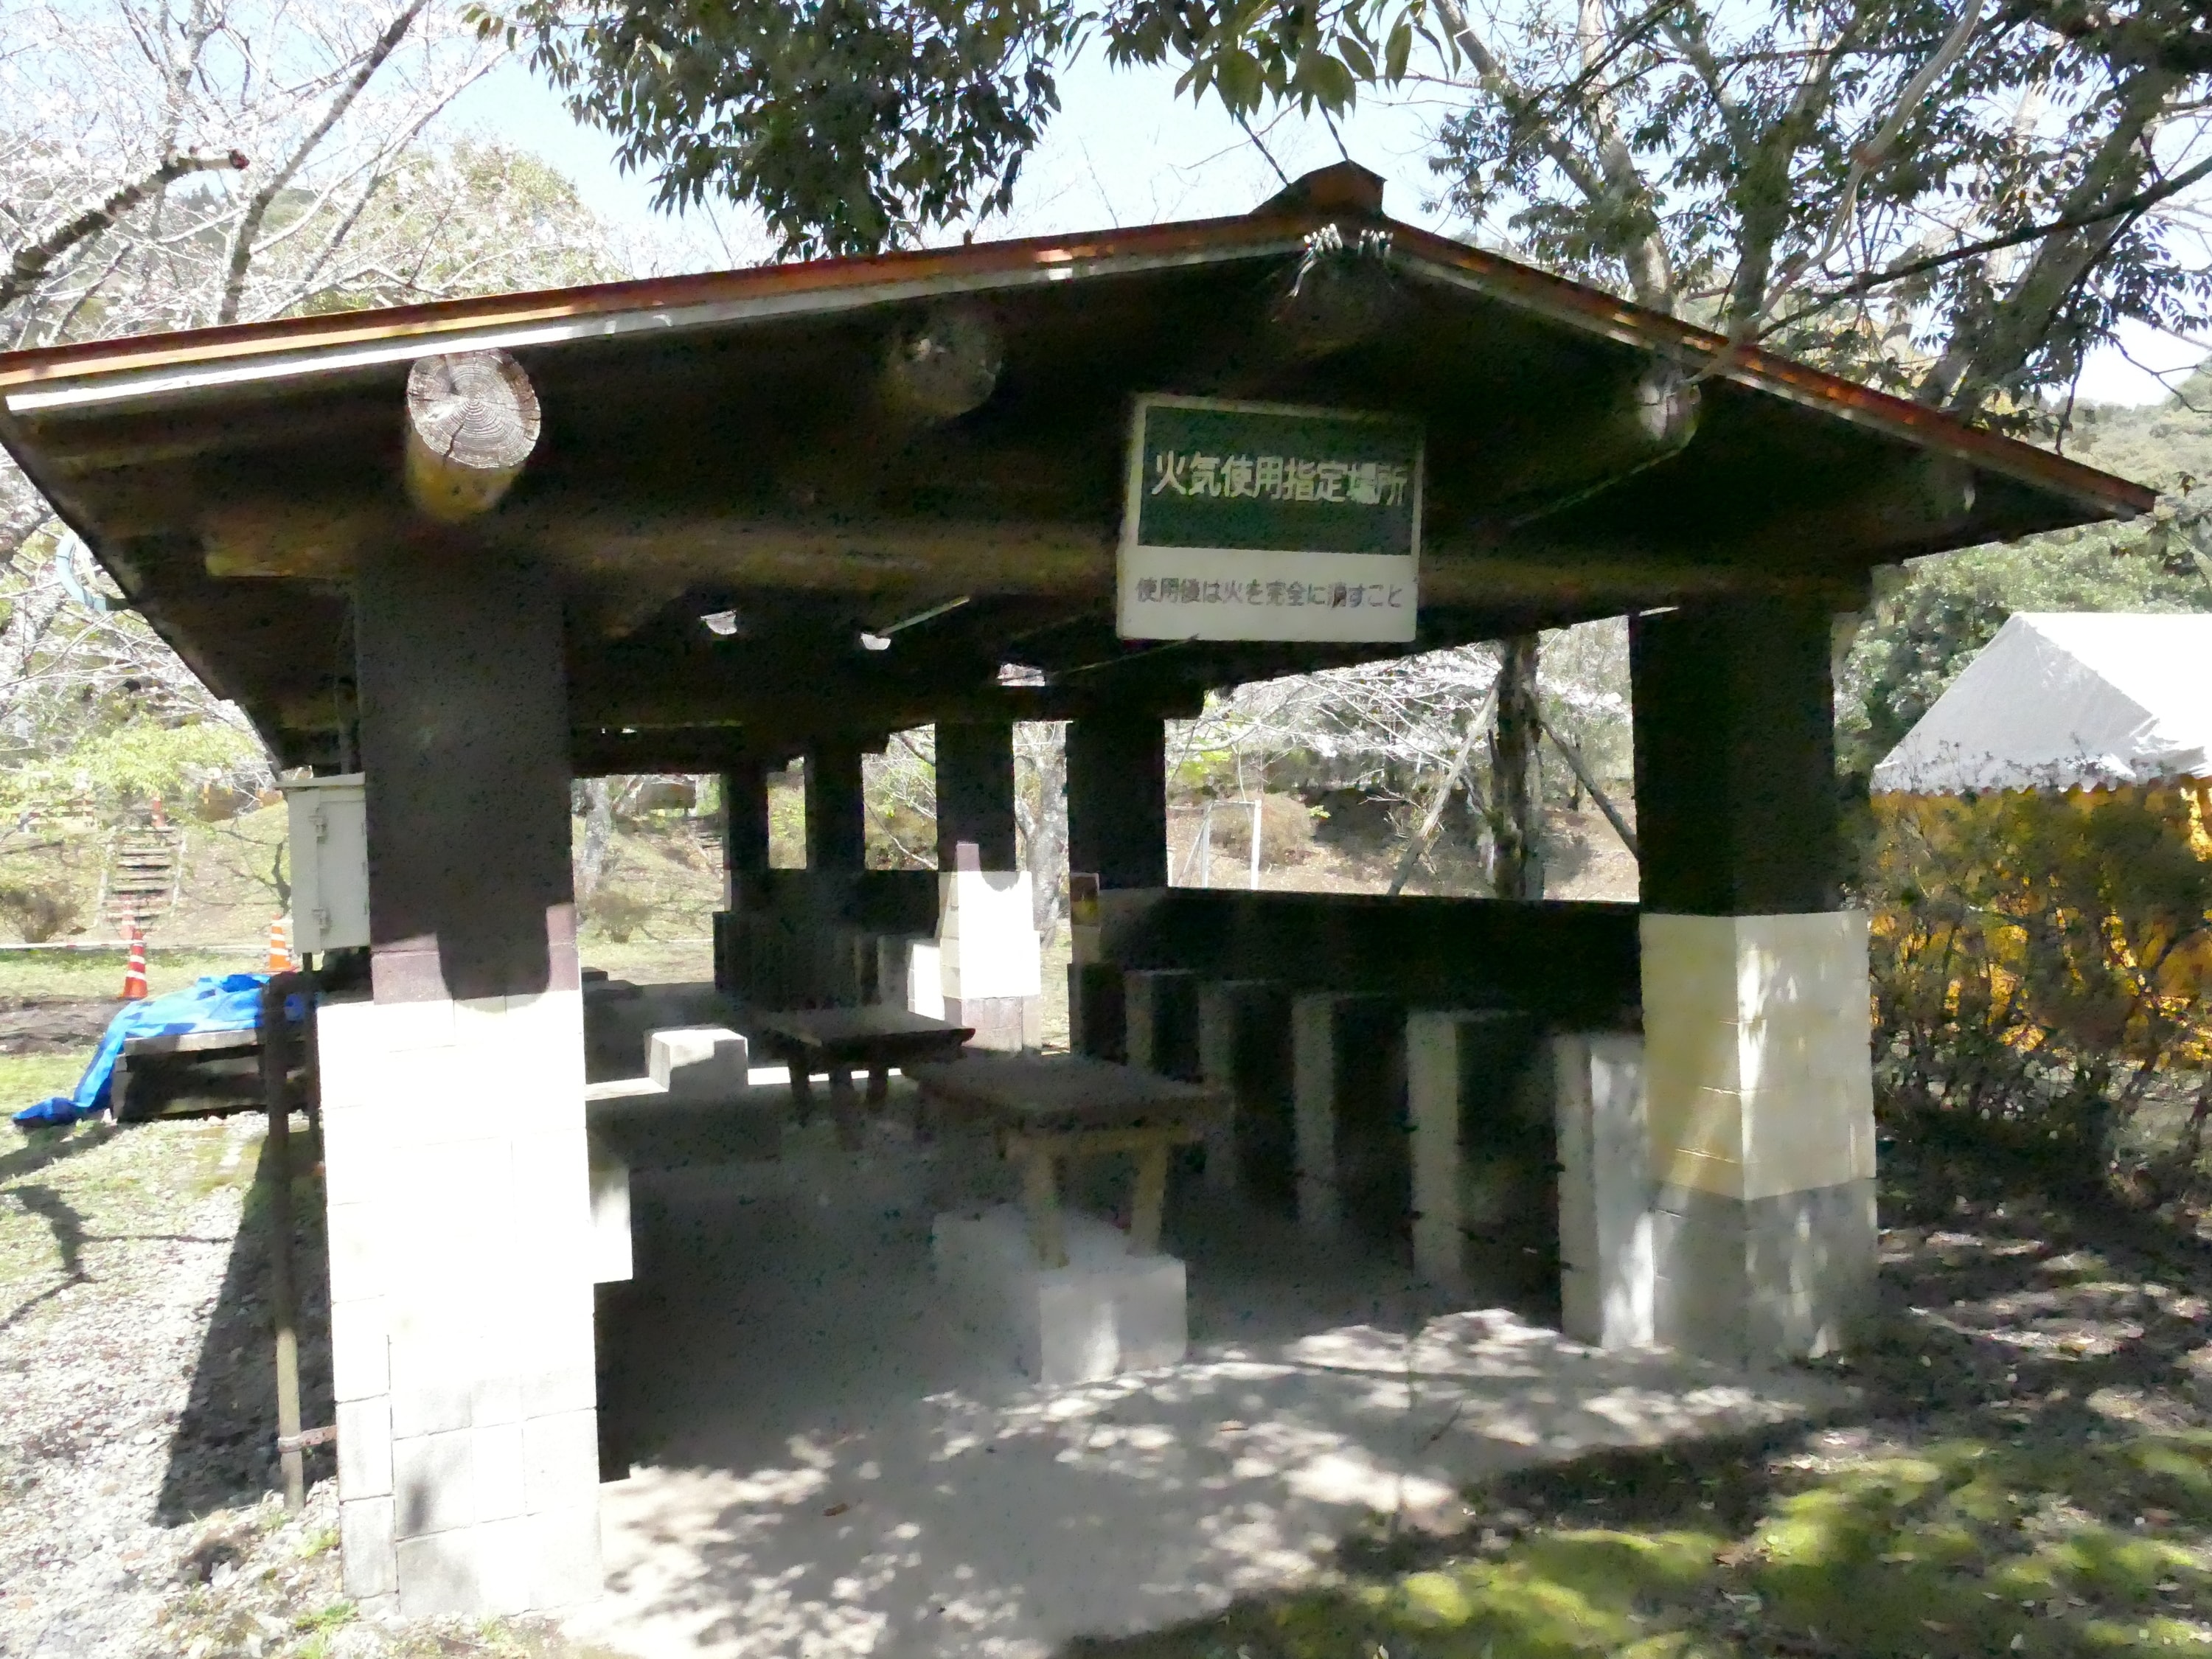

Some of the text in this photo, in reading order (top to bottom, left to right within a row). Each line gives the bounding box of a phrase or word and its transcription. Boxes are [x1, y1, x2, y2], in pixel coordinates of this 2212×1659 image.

[1151, 450, 1408, 506] 火気使用指定場所
